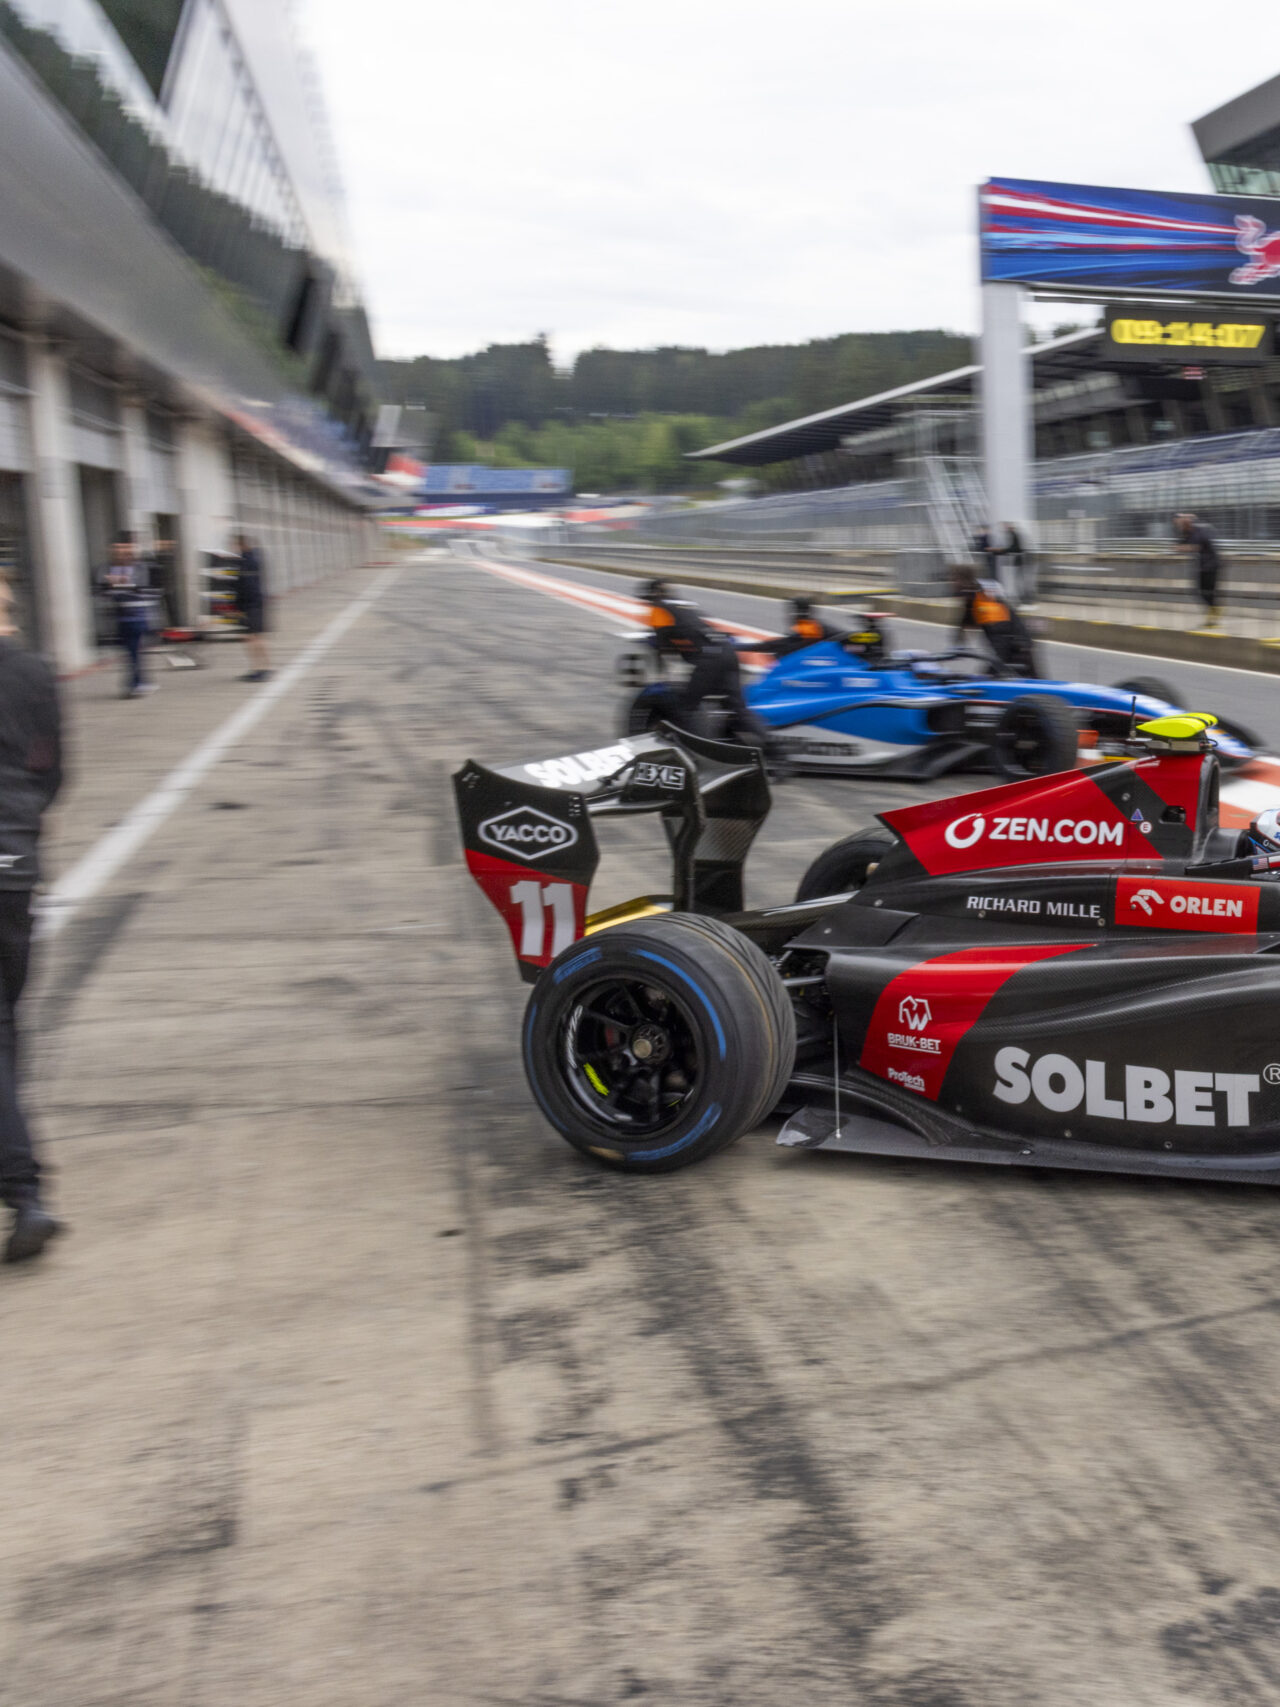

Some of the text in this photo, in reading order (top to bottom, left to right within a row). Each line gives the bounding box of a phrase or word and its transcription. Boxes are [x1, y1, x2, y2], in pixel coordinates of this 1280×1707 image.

[490, 824, 567, 843] YACCO
[988, 817, 1124, 846] ZEN.COM
[967, 896, 1101, 918] RICHARD MILLE
[1170, 896, 1243, 918] ORLEN
[509, 880, 575, 958] 11
[887, 1032, 941, 1051] BRUK-BET
[887, 1067, 925, 1088] ProTech
